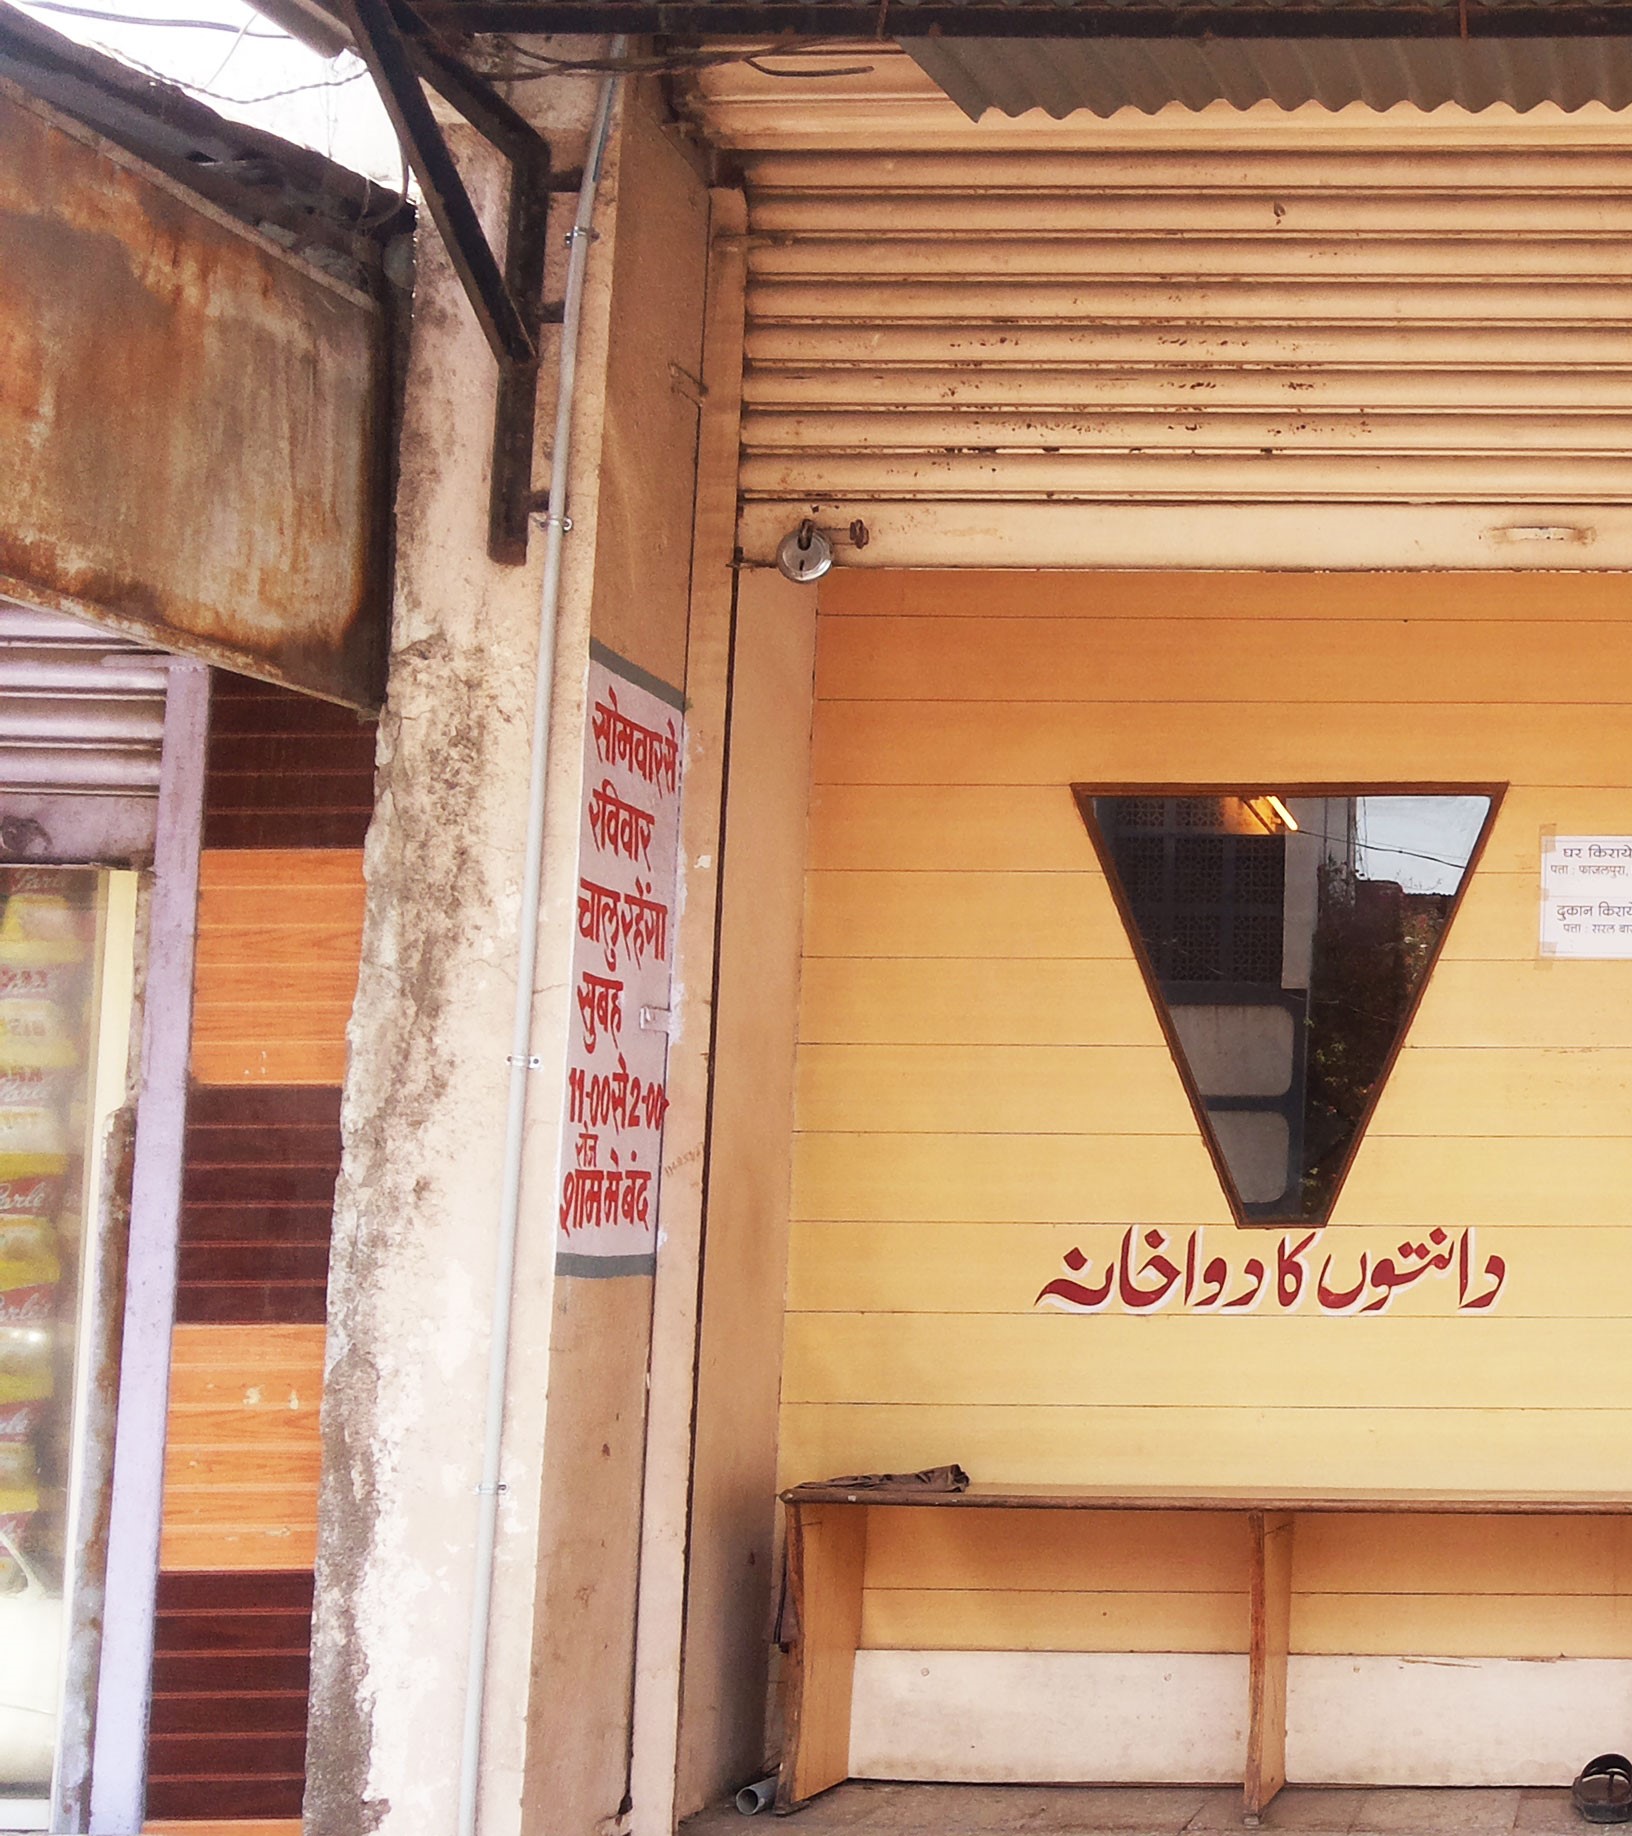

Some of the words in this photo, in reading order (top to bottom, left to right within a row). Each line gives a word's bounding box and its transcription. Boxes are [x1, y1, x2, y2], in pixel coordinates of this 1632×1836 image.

[592, 685, 663, 799] सोमवार
[663, 718, 679, 794] से
[588, 778, 655, 872] रविवार
[1563, 847, 1583, 859] घर
[1588, 844, 1632, 859] किराये
[1556, 905, 1593, 921] दुकान
[577, 971, 624, 1054] सुबह
[559, 1168, 604, 1238] शाम
[622, 1151, 651, 1232] बंद
[1276, 1230, 1321, 1309] کا
